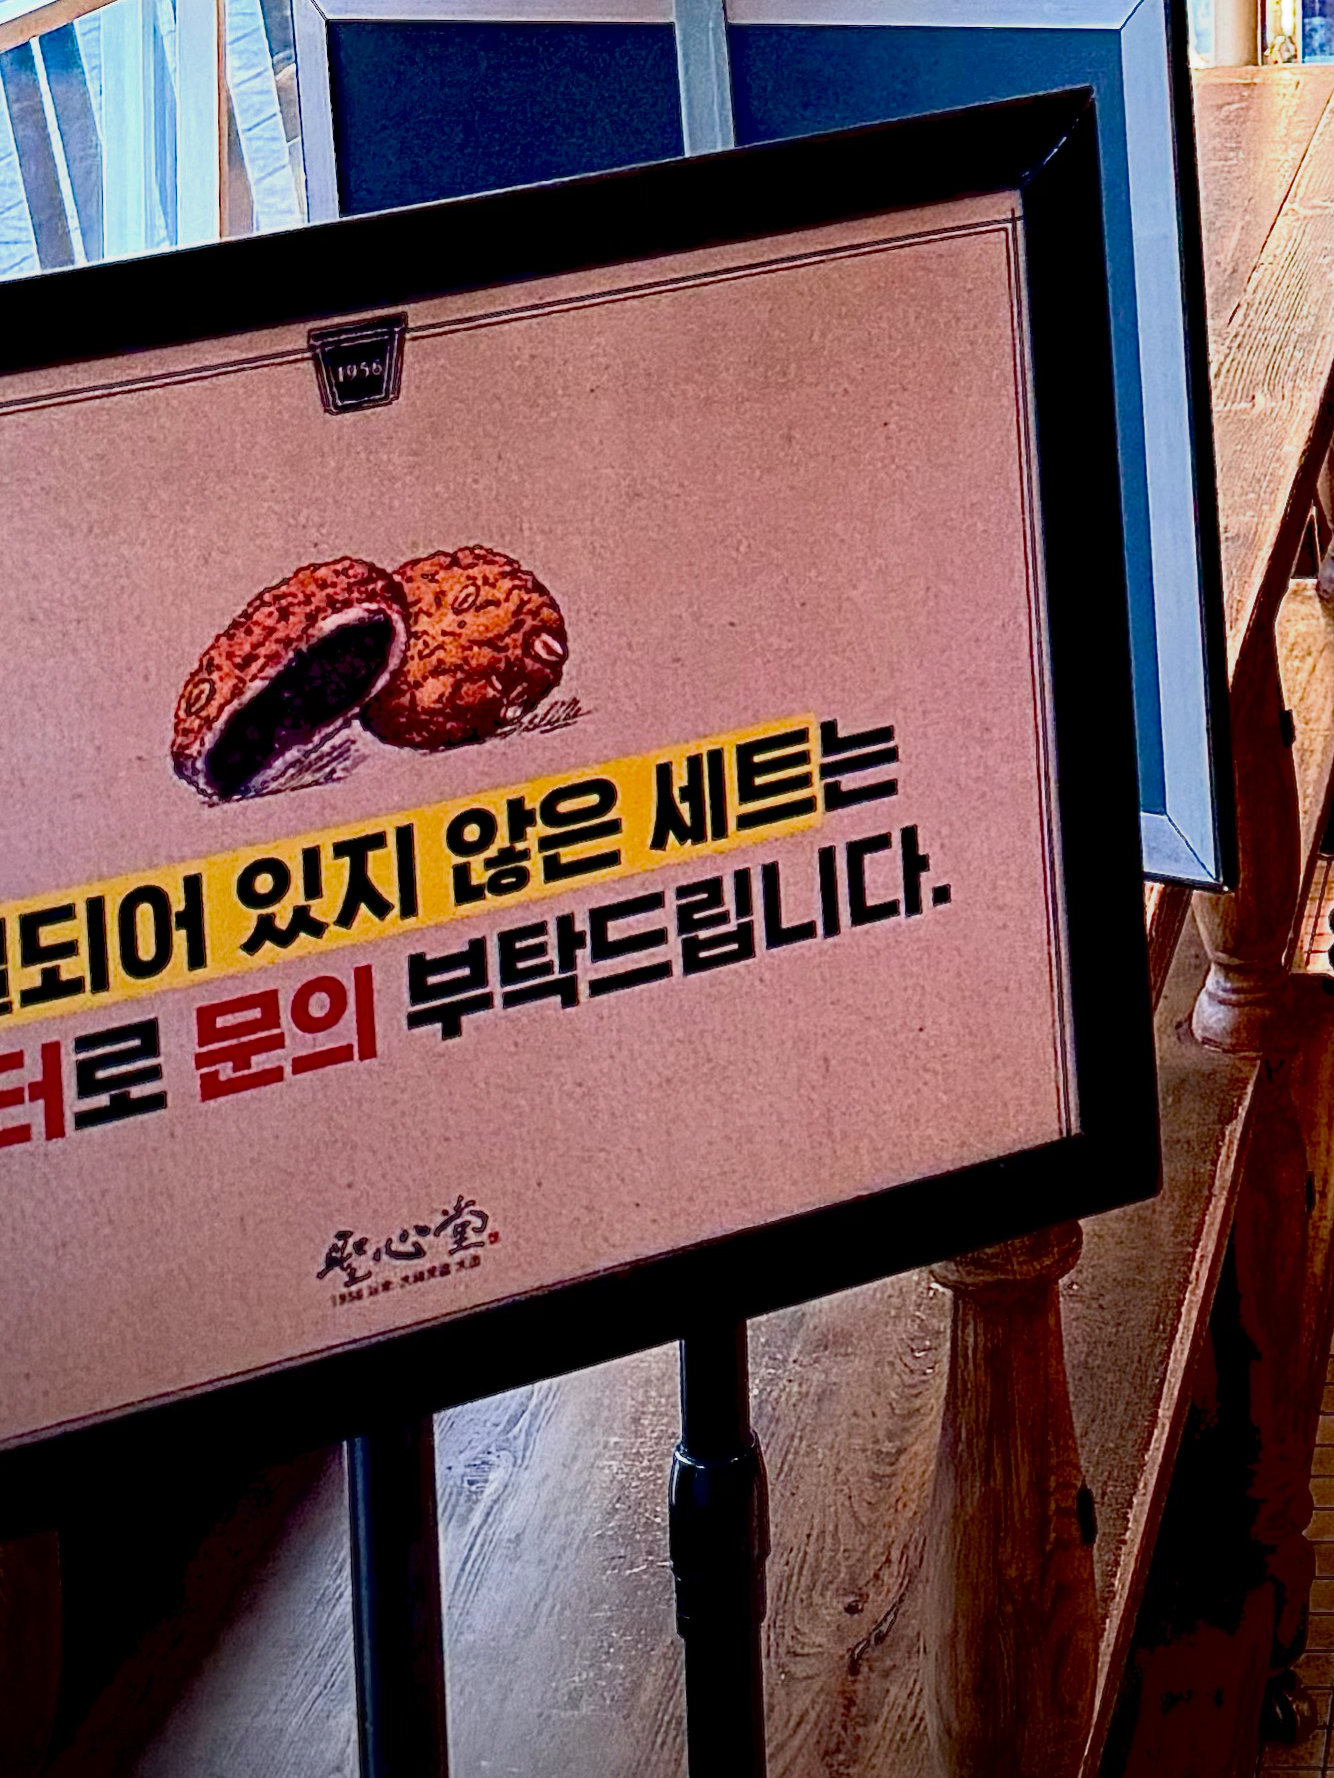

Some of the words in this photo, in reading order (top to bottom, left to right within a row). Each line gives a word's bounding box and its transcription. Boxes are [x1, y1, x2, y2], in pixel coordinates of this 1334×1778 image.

[338, 359, 383, 383] 1956
[236, 823, 420, 956] 있지
[446, 777, 623, 907] 않은
[649, 718, 901, 852] 세트는
[194, 964, 378, 1103] 문의
[406, 823, 953, 1041] 부탁드립니다.
